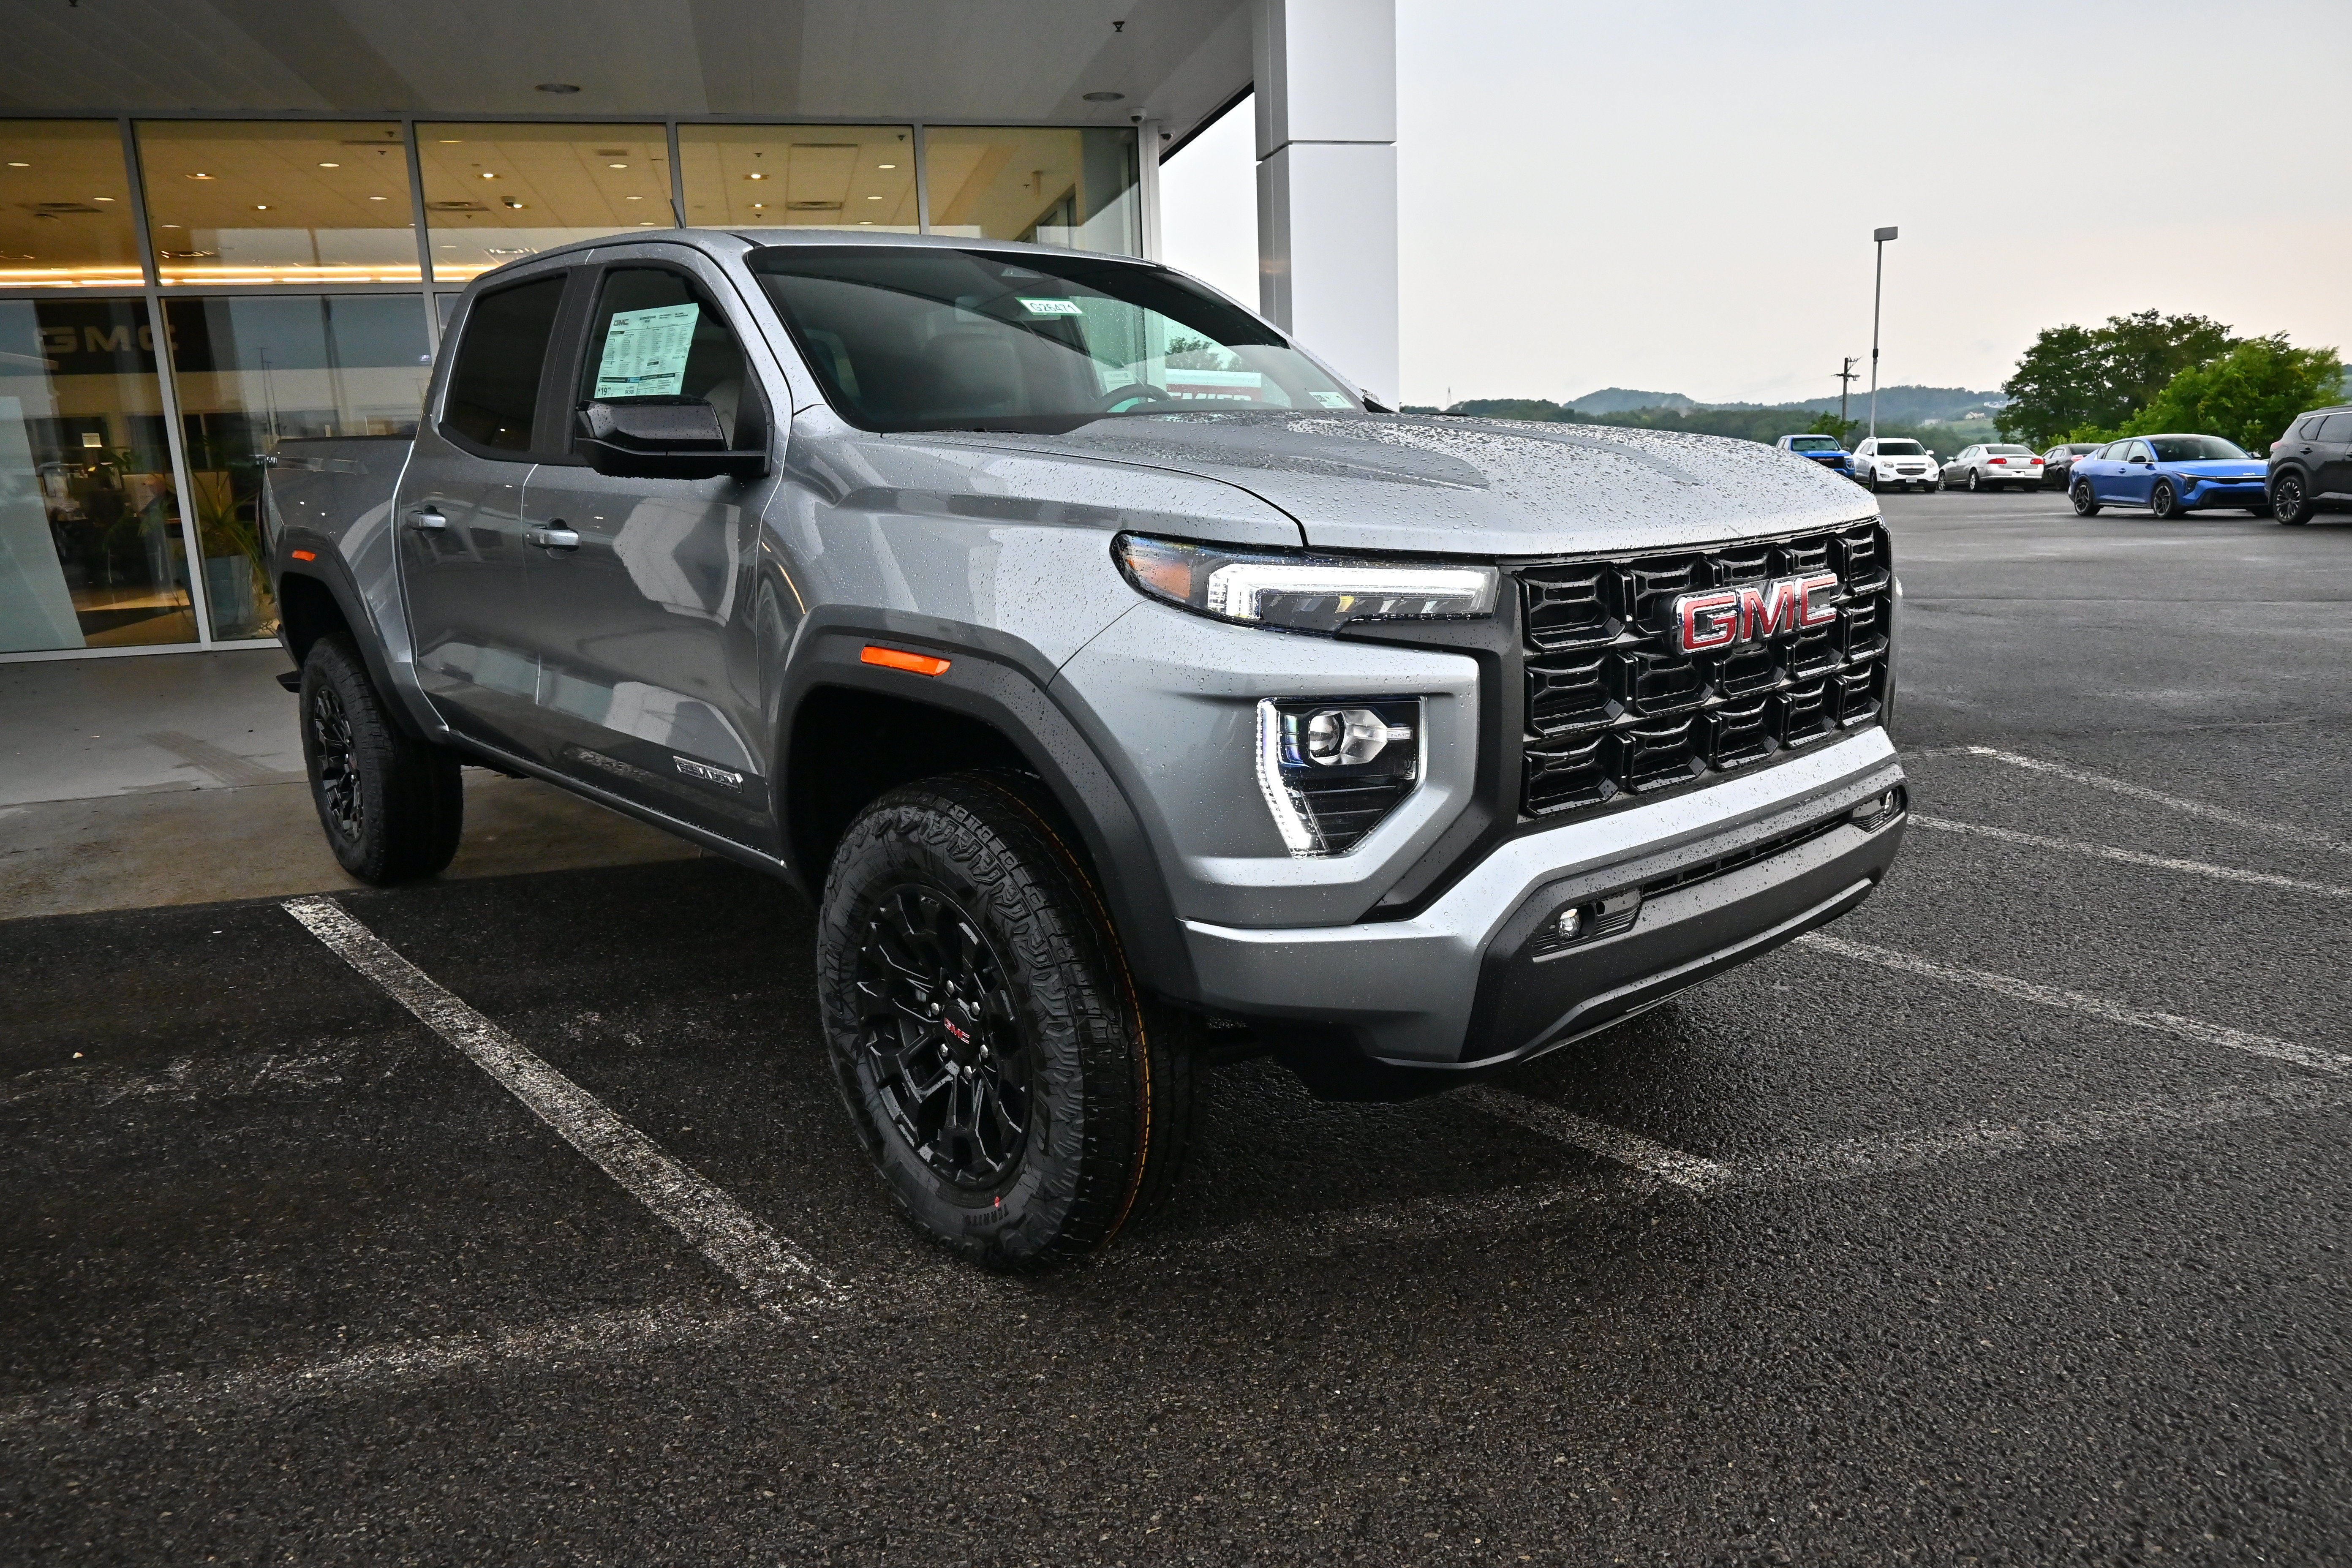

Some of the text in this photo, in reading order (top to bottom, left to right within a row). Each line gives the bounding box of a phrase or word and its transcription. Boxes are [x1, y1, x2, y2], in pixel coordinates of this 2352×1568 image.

[1029, 302, 1077, 313] G26471
[33, 325, 179, 354] GMC
[1677, 572, 1838, 654] GMC
[944, 1018, 970, 1044] GMC
